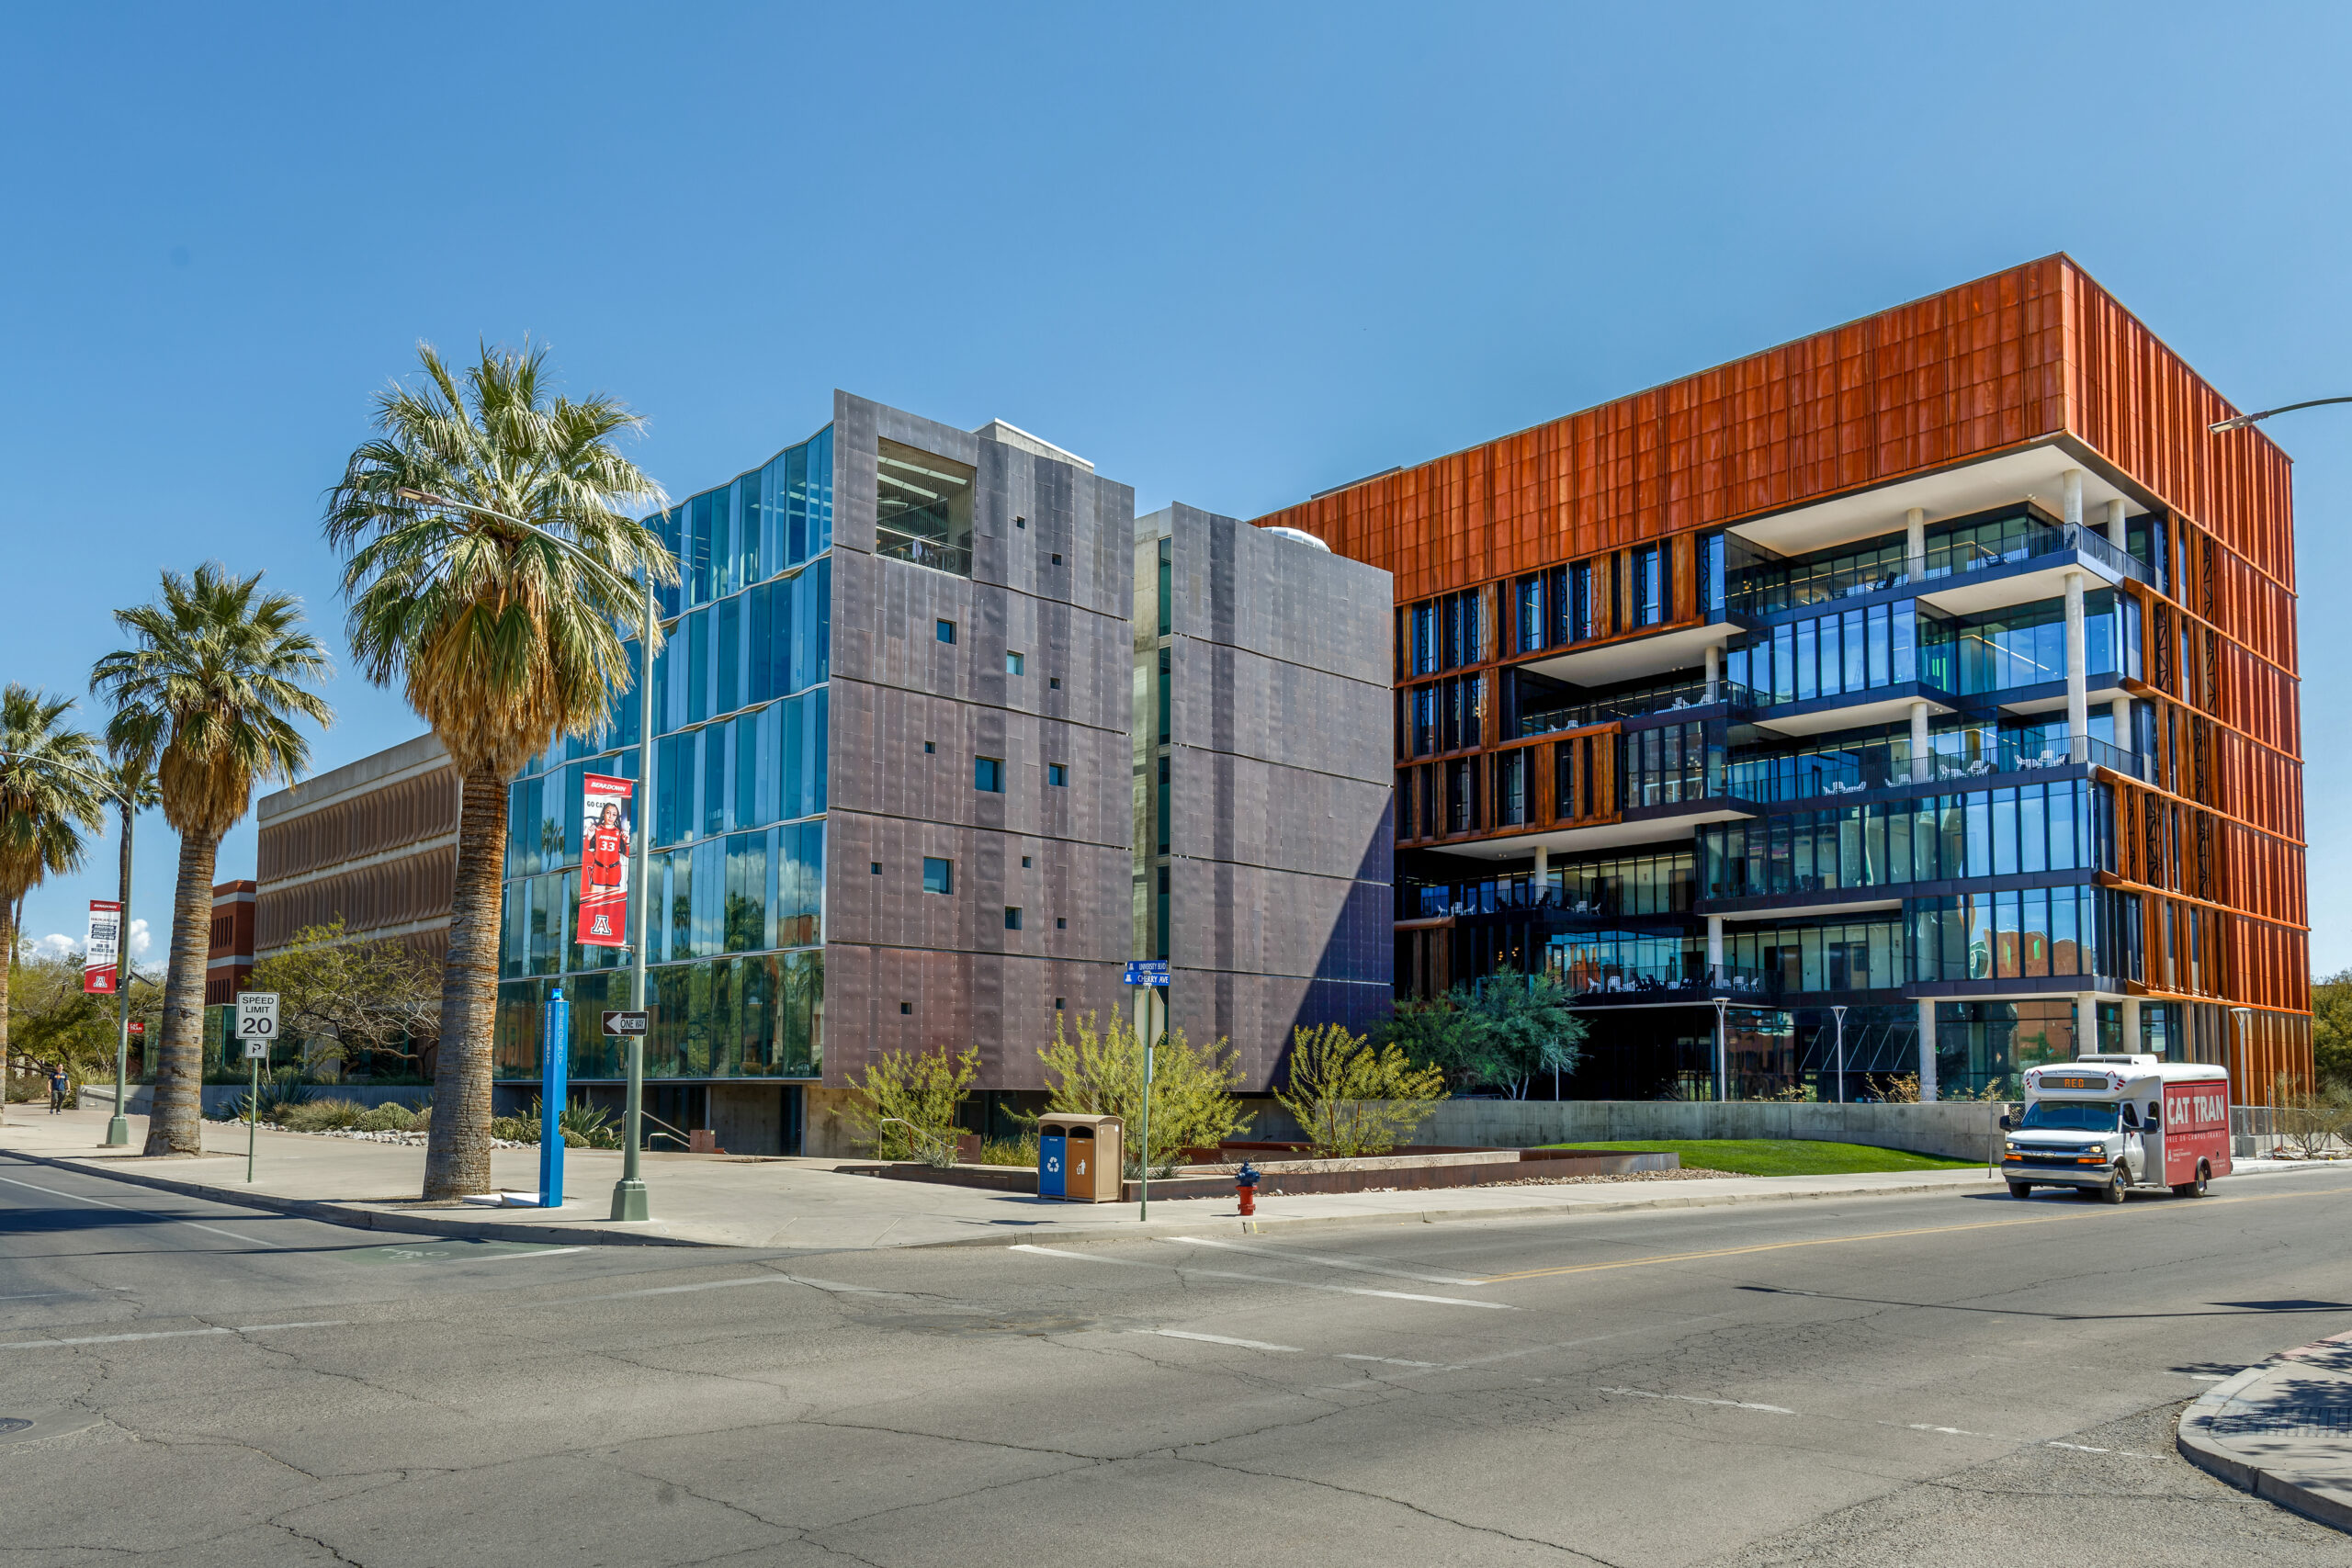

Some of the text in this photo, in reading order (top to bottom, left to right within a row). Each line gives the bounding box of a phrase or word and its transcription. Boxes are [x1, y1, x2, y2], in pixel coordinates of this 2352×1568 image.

[591, 782, 627, 792] BEARDOWN
[600, 840, 616, 852] 33
[1137, 975, 1158, 983] CHERRY
[1159, 976, 1169, 984] AVE
[243, 1017, 272, 1034] 20
[620, 1019, 644, 1028] ONE WAY
[2064, 1078, 2084, 1088] RED
[2167, 1095, 2224, 1124] CAT TRAN
[2179, 1133, 2206, 1141] ON-CAMPUS
